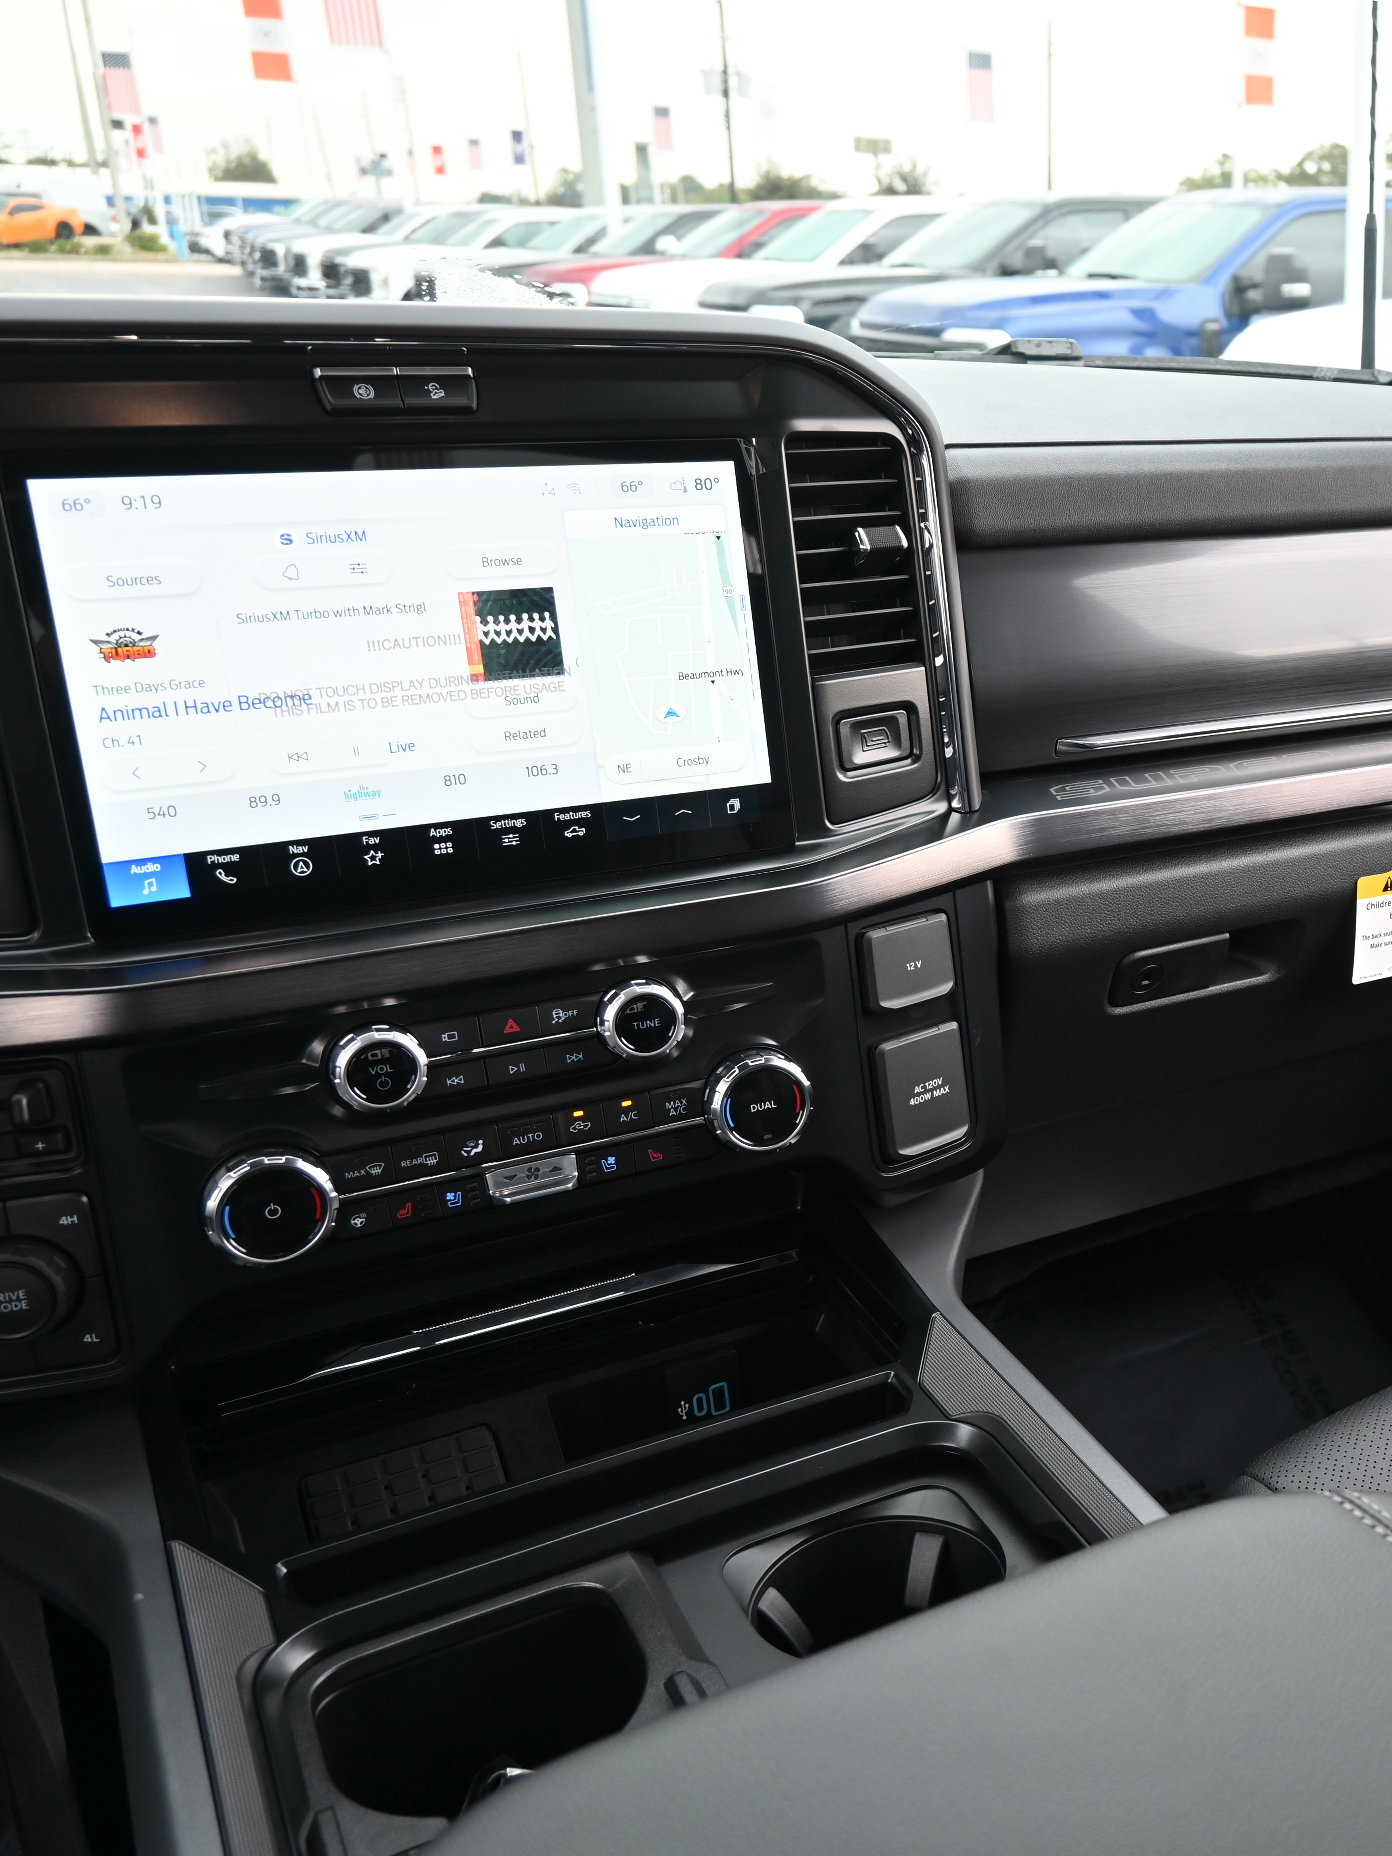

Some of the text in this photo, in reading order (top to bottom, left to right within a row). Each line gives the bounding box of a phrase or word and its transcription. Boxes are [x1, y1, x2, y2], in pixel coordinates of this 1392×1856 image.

[620, 477, 720, 493] 66° 80°
[61, 494, 162, 512] 66° 9:19
[614, 515, 680, 529] Navigation
[305, 530, 367, 545] SiriusXM
[481, 555, 523, 568] Browse
[106, 573, 162, 588] Sources
[236, 601, 427, 625] SiriusXM Turbo with Mark Strigl
[100, 645, 157, 663] TURBO
[678, 668, 724, 681] Beaumont
[92, 677, 205, 697] Three Days Grace
[318, 683, 365, 699] TOUCH
[369, 678, 425, 695] DISPLAY
[428, 674, 480, 690] DURING
[99, 704, 169, 723] Animal
[184, 699, 232, 716] Have
[238, 690, 313, 712] Become
[271, 680, 566, 719] THIS FILM IS TO BE REMOVED BEFORE USAGE
[503, 693, 540, 707] Sound
[102, 734, 143, 749] Ch. 41
[503, 727, 547, 742] Related
[388, 740, 415, 755] Live
[525, 762, 559, 778] 106.3
[616, 754, 710, 775] NE Crosby
[443, 772, 467, 787] 810
[248, 793, 281, 809] 89.9
[146, 804, 177, 820] 540
[554, 808, 591, 822] Features
[490, 815, 527, 831] Settings
[429, 826, 453, 839] Apps
[362, 834, 380, 846] Fav
[288, 842, 309, 855] Nav
[206, 850, 240, 865] Phone
[129, 861, 161, 875] Audio
[1372, 932, 1382, 940] back
[1383, 930, 1392, 938] seat
[906, 960, 922, 971] 12 V
[562, 1008, 578, 1019] OFF
[632, 1018, 661, 1031] TUNE
[368, 1064, 394, 1075] VOL
[914, 1077, 943, 1094] AC 120V
[909, 1085, 950, 1106] 400W MAX
[665, 1098, 688, 1110] MAX
[669, 1105, 688, 1116] A/C
[750, 1100, 777, 1113] DUAL
[620, 1111, 639, 1123] A/C
[512, 1131, 543, 1146] AUTO
[401, 1156, 424, 1168] REAR
[345, 1168, 366, 1179] MAX
[59, 1215, 78, 1226] 4H
[0, 1289, 27, 1300] RIVE
[83, 1333, 100, 1344] 4L
